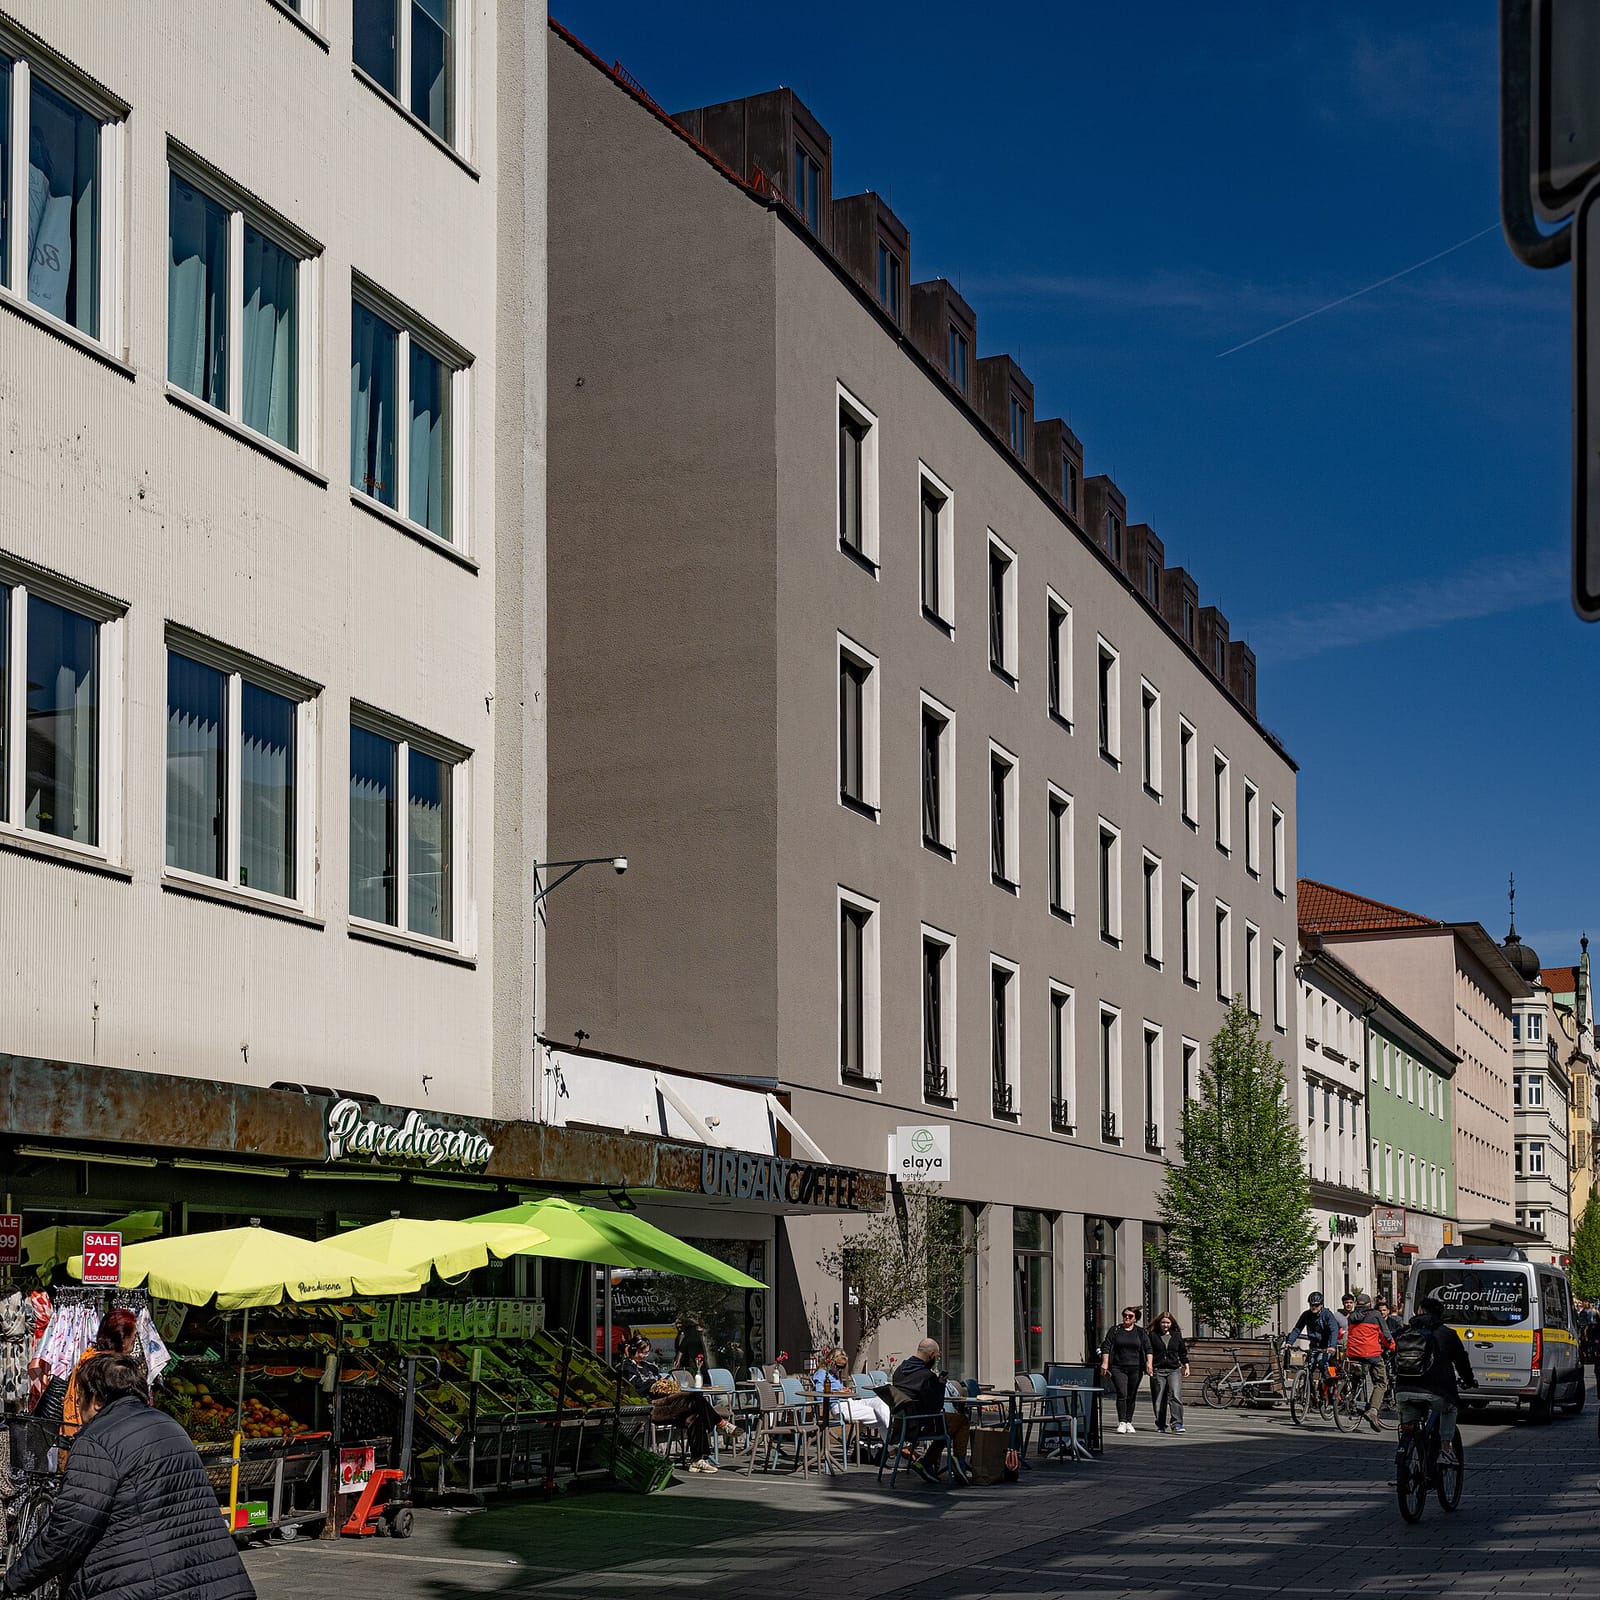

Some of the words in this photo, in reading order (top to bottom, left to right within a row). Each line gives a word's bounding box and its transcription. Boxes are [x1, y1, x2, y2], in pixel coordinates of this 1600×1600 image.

[328, 1098, 494, 1167] Paradiesana
[902, 1154, 943, 1172] elaya
[1376, 1219, 1403, 1227] STERN
[86, 1235, 119, 1246] SALE
[85, 1252, 118, 1267] 7.99
[1443, 1287, 1522, 1304] airportliner
